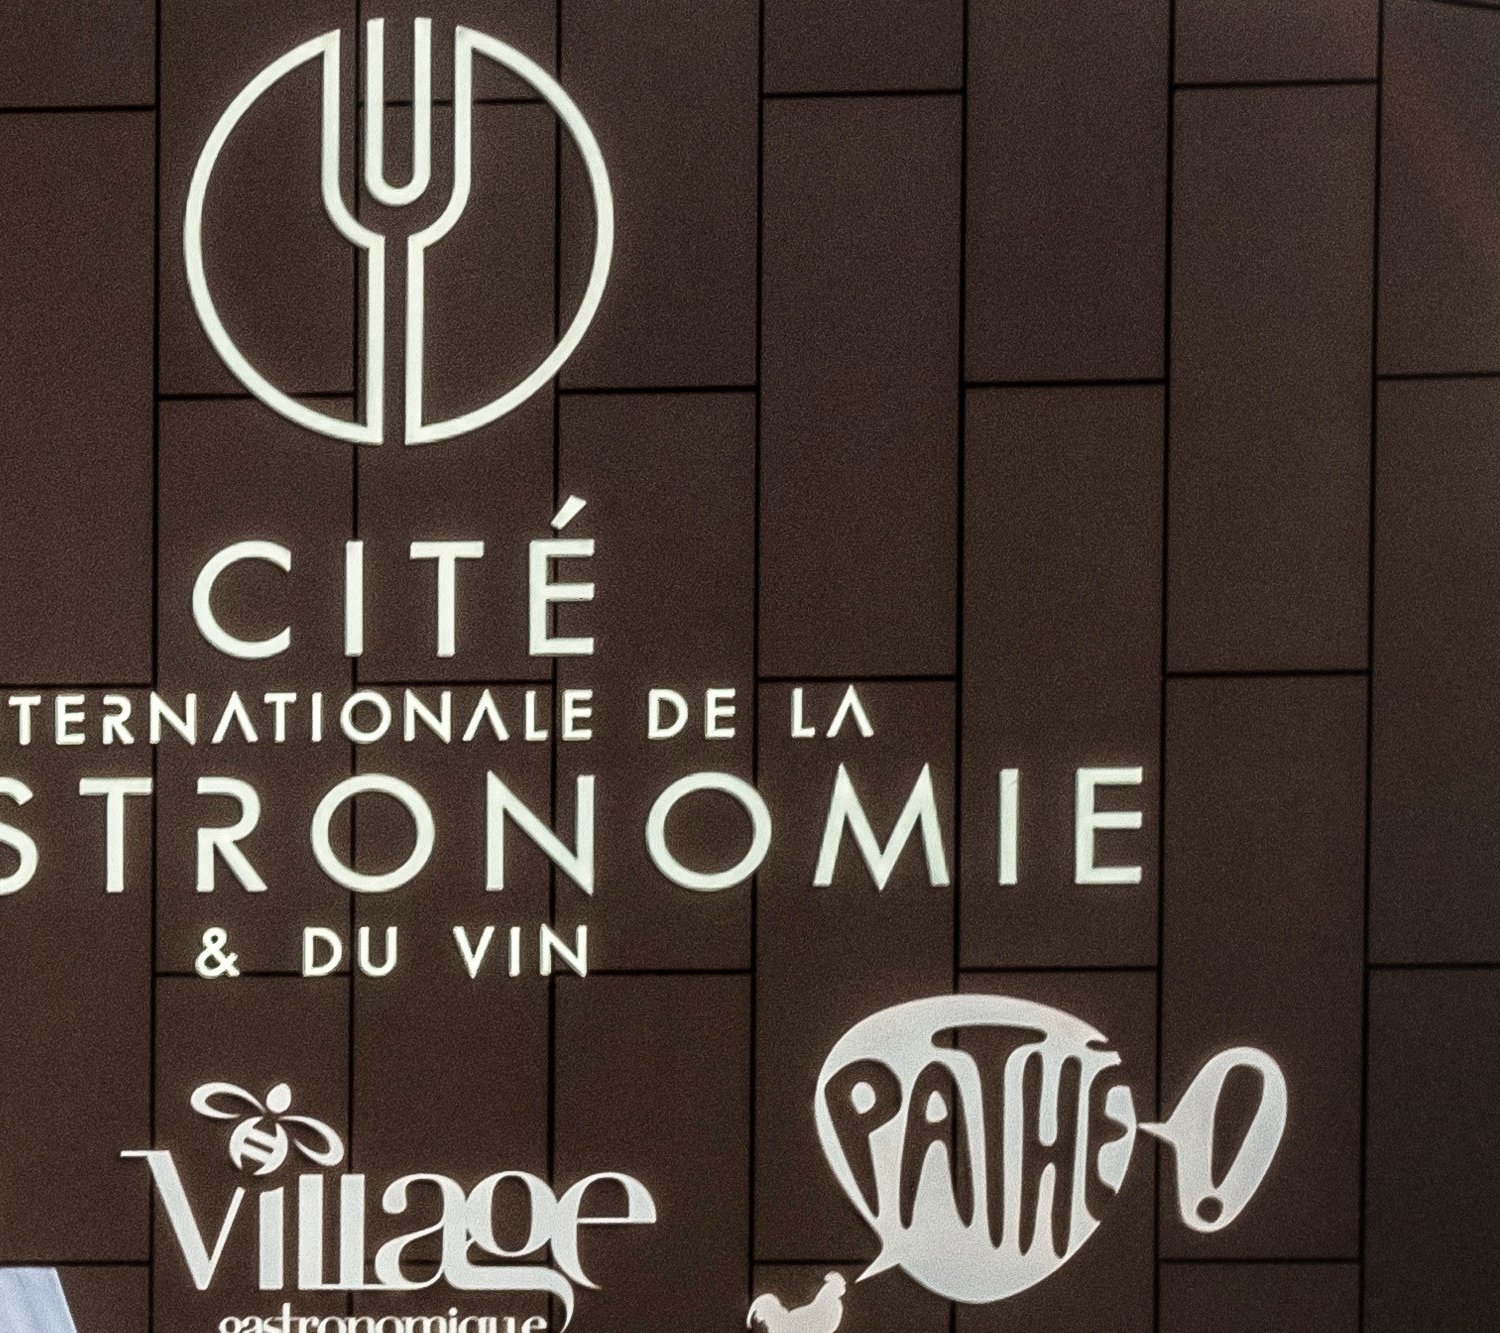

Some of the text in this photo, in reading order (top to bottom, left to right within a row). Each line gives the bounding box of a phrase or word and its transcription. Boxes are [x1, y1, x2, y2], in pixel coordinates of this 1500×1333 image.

[191, 494, 595, 659] CITÉ
[647, 687, 736, 739] DE
[790, 684, 874, 739] LA
[194, 922, 589, 979] & DU VIN
